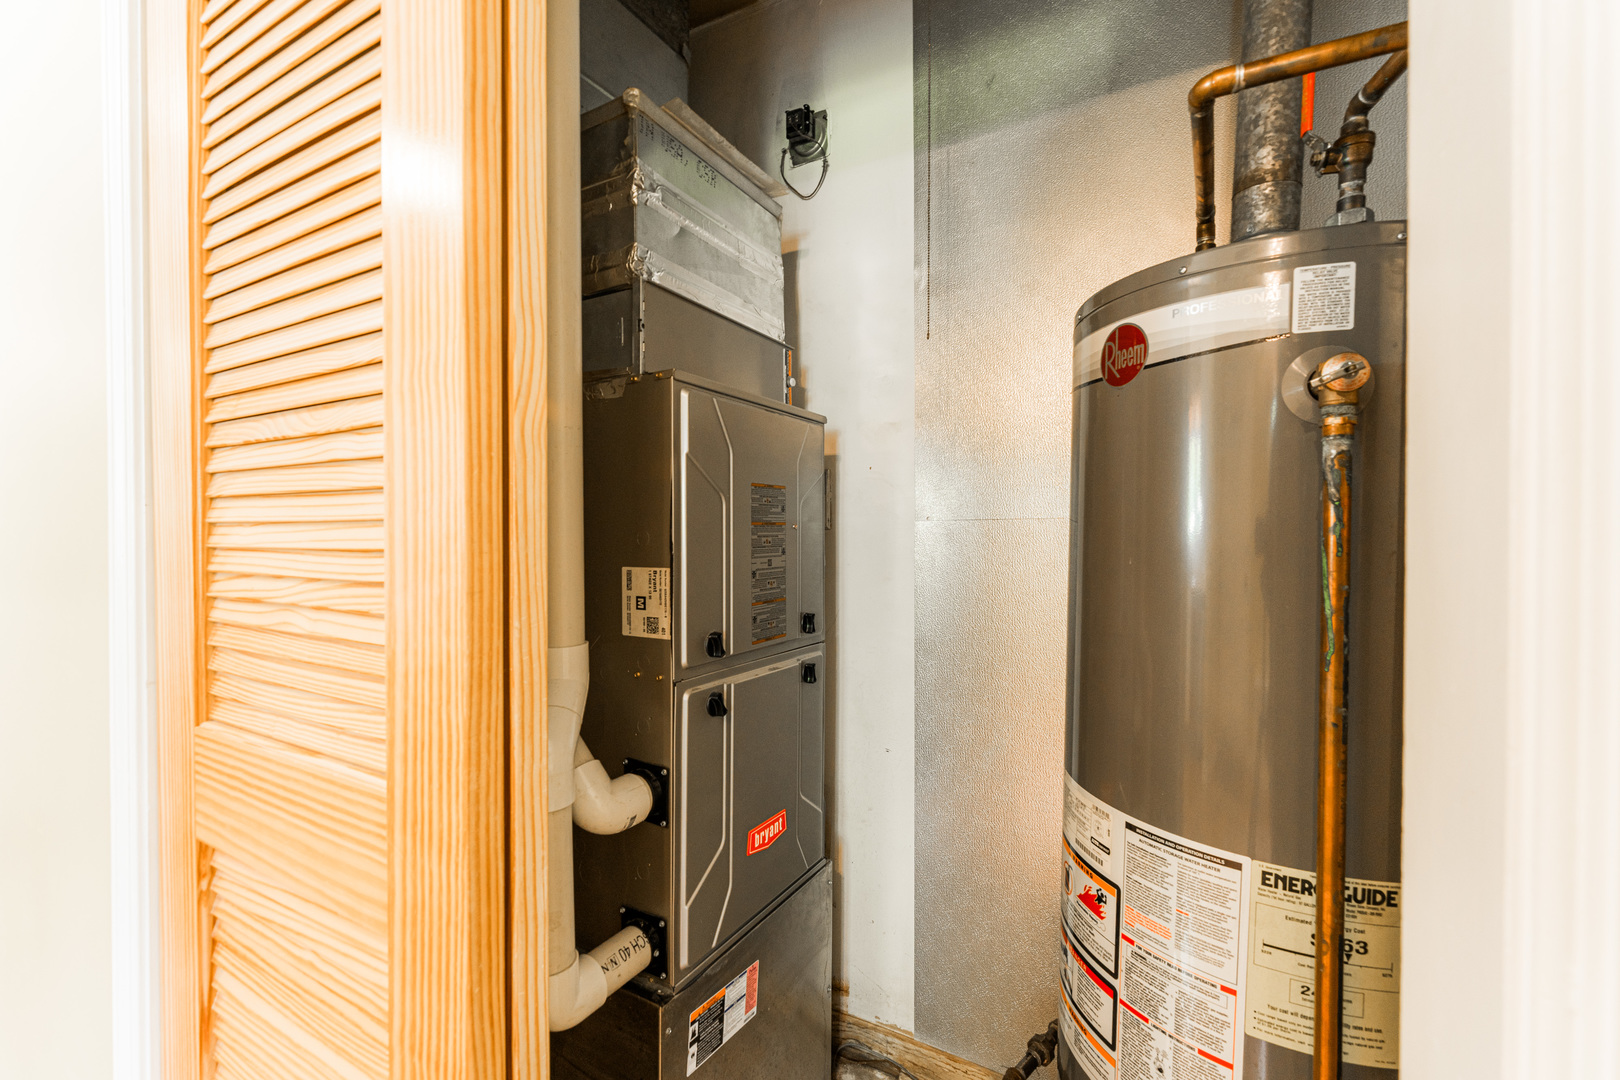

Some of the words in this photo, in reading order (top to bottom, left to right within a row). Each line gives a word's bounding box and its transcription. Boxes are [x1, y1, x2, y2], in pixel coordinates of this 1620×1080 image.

[1105, 328, 1144, 379] Rheem
[638, 598, 644, 609] M
[754, 817, 783, 848] bryant
[618, 946, 631, 962] 40
